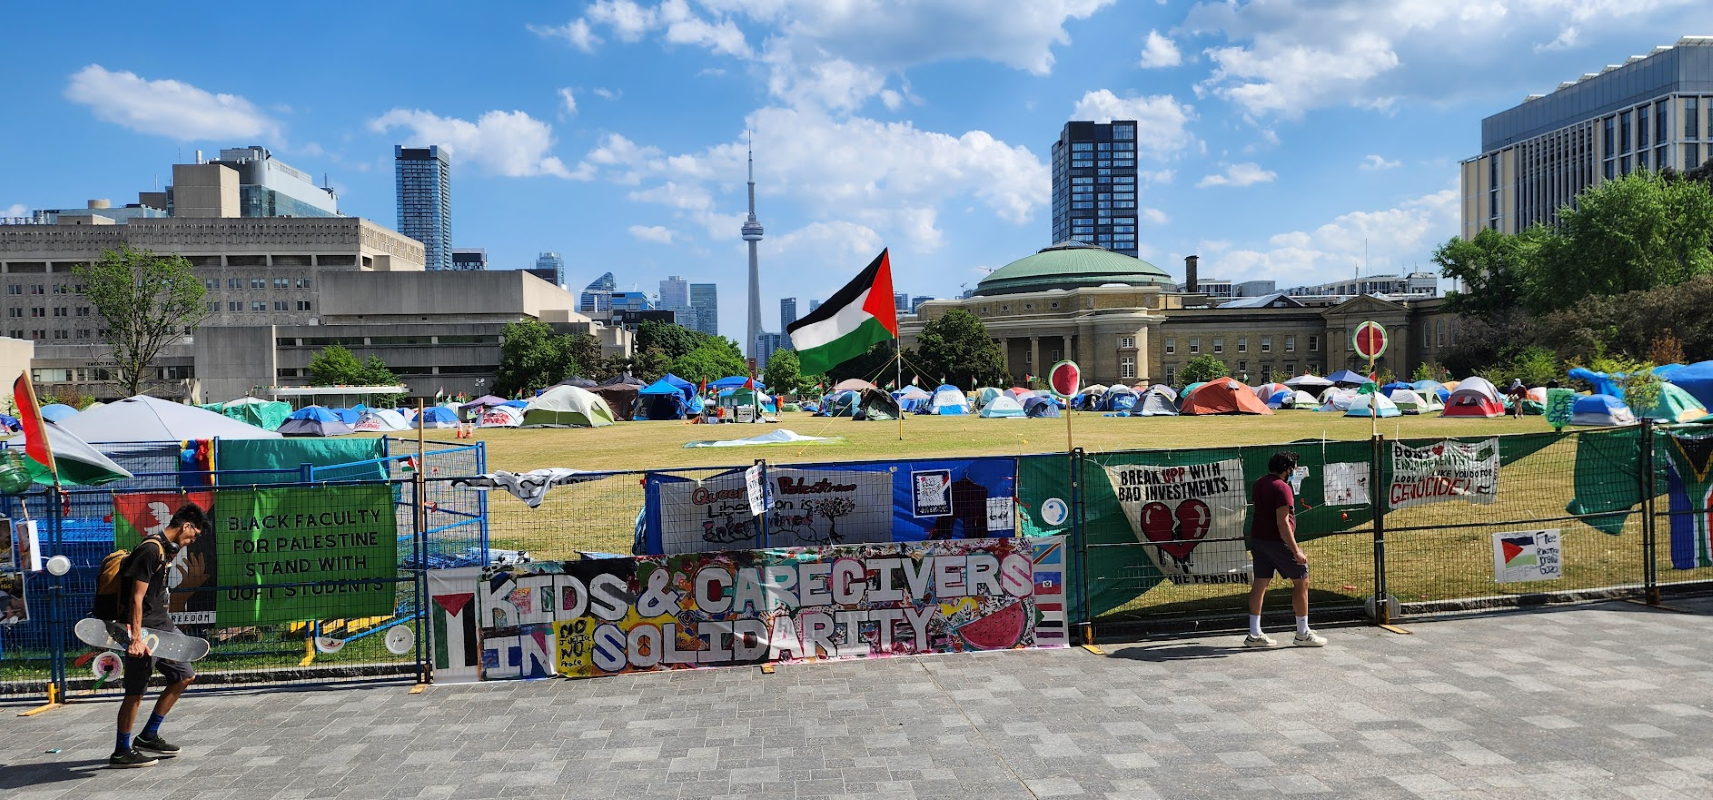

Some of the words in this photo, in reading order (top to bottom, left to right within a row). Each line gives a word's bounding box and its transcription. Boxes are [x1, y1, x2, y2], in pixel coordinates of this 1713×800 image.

[1121, 470, 1160, 485] BREAK
[1162, 467, 1185, 484] UPP
[1189, 463, 1220, 480] WITH
[1118, 487, 1141, 502] BAD
[1145, 477, 1229, 500] INVESTMENTS
[228, 514, 289, 531] BLACK
[295, 509, 380, 528] FACULTY
[233, 538, 269, 554] FOR
[276, 531, 378, 552] PALESTINE
[245, 558, 311, 577] STAND
[318, 555, 367, 572] WITH
[284, 578, 384, 598] STUDENTS
[1193, 573, 1249, 585] PENSION
[479, 573, 628, 629] KIDS
[636, 566, 682, 618] &
[695, 552, 1033, 614] CAREGIVERS
[172, 613, 210, 623] REEDOM
[560, 619, 587, 638] NO
[482, 633, 556, 679] IN
[591, 605, 937, 673] SOLIDARITY
[560, 641, 584, 660] NO
